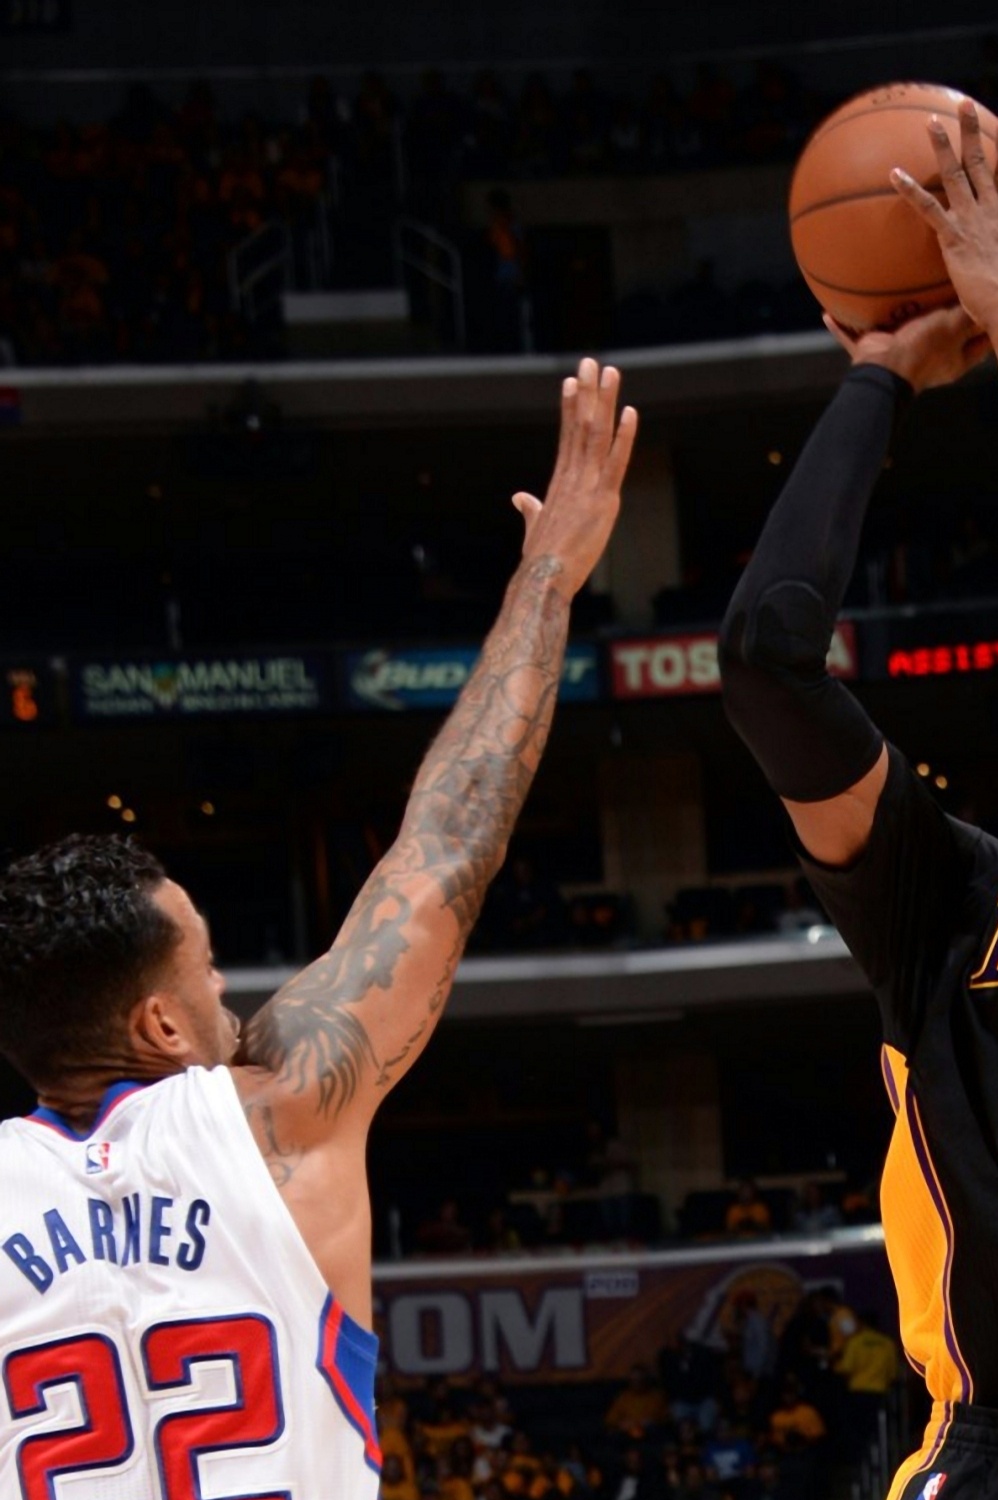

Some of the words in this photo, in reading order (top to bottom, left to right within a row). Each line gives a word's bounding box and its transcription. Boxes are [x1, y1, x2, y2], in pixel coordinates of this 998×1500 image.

[82, 662, 154, 695] SAN
[176, 655, 317, 693] MANUEL
[2, 1192, 212, 1295] BARNES
[374, 1288, 588, 1376] OM
